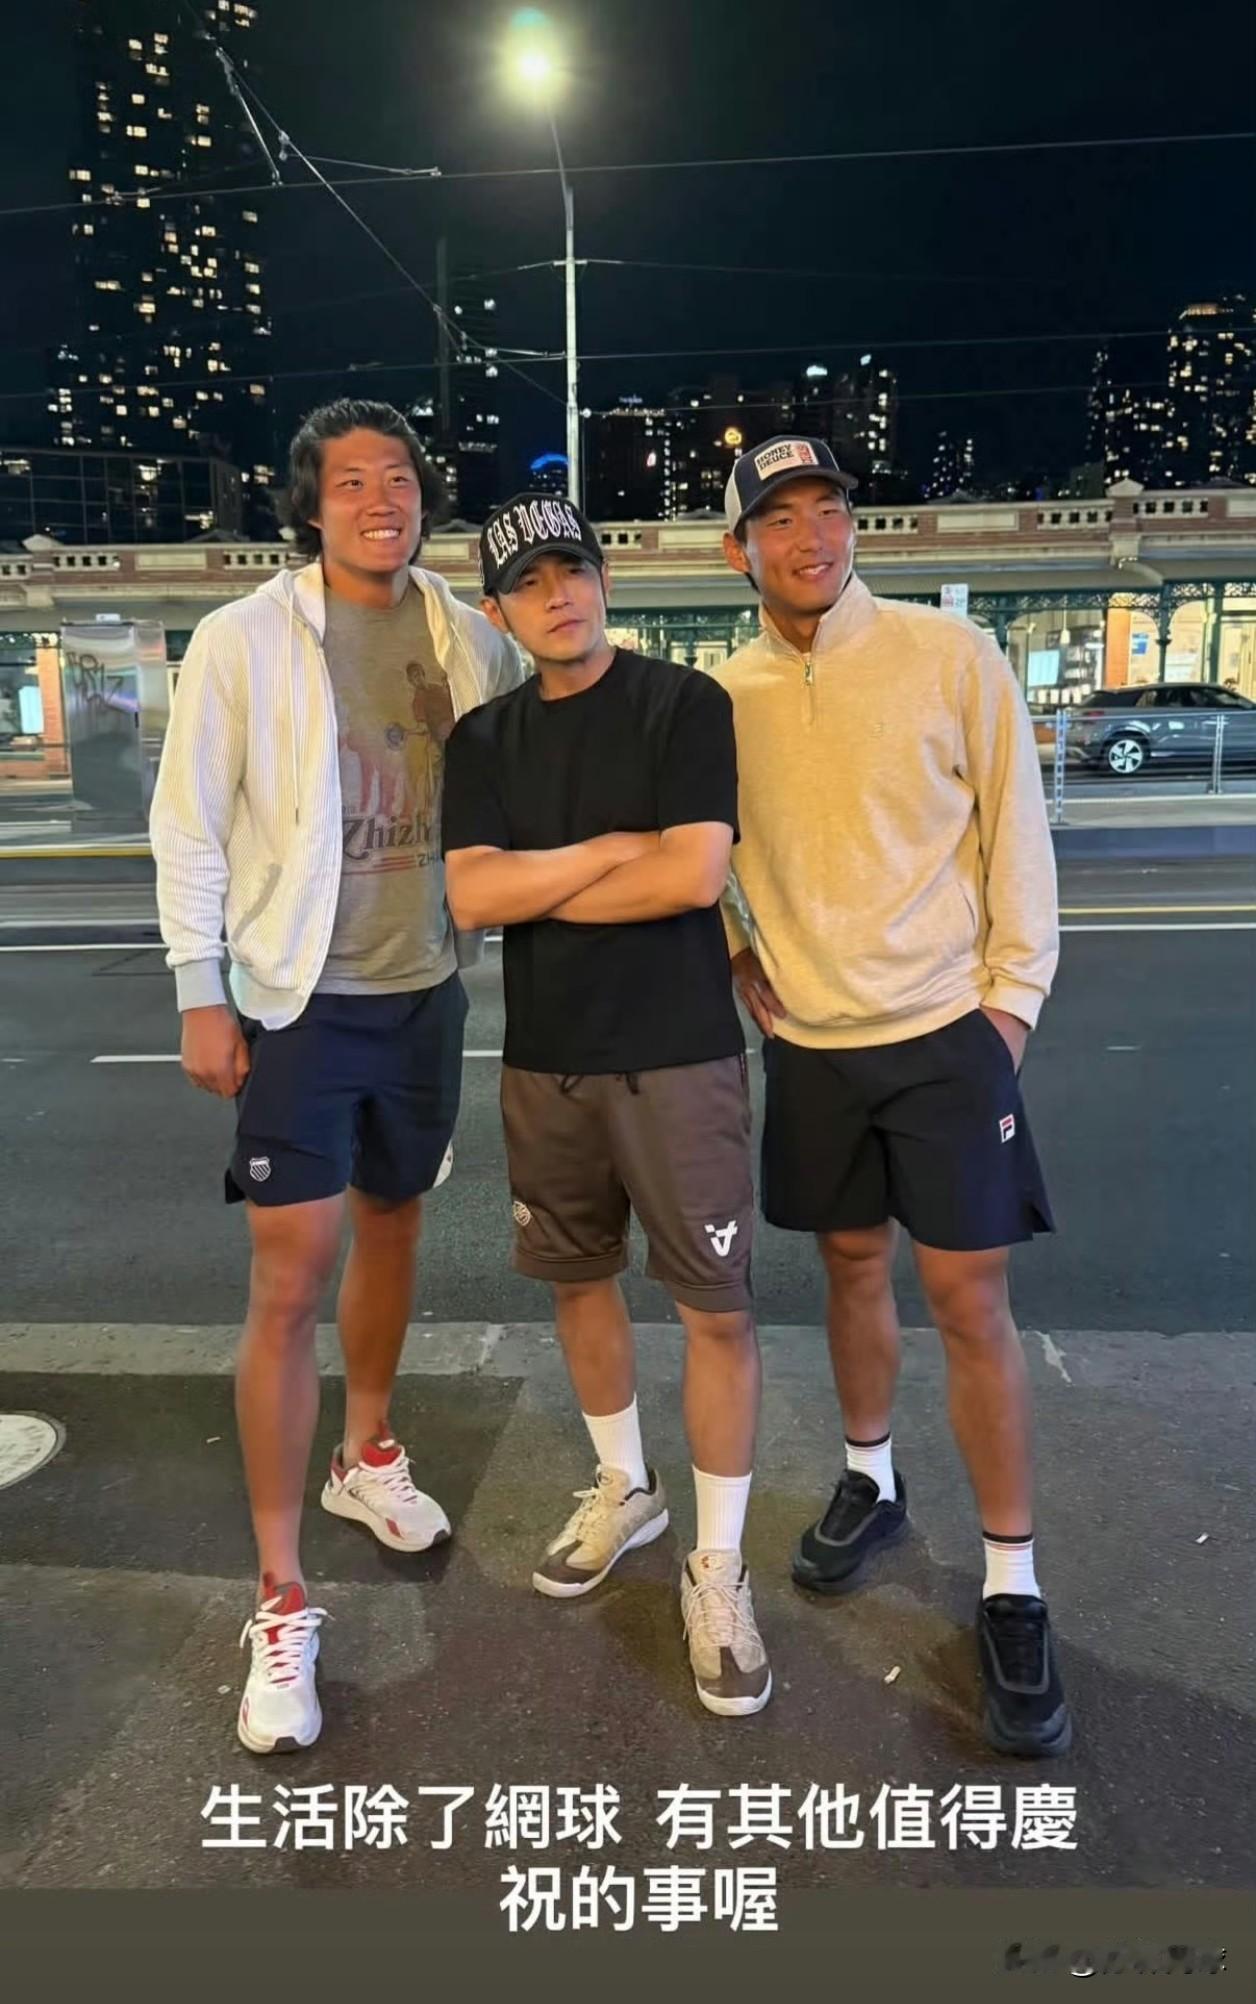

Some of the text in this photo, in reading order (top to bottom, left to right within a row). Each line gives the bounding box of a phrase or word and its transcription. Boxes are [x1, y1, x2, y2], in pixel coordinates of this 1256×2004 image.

[757, 444, 792, 466] HONEY
[760, 450, 794, 470] DEUCE
[487, 500, 582, 569] LAS VEGAS
